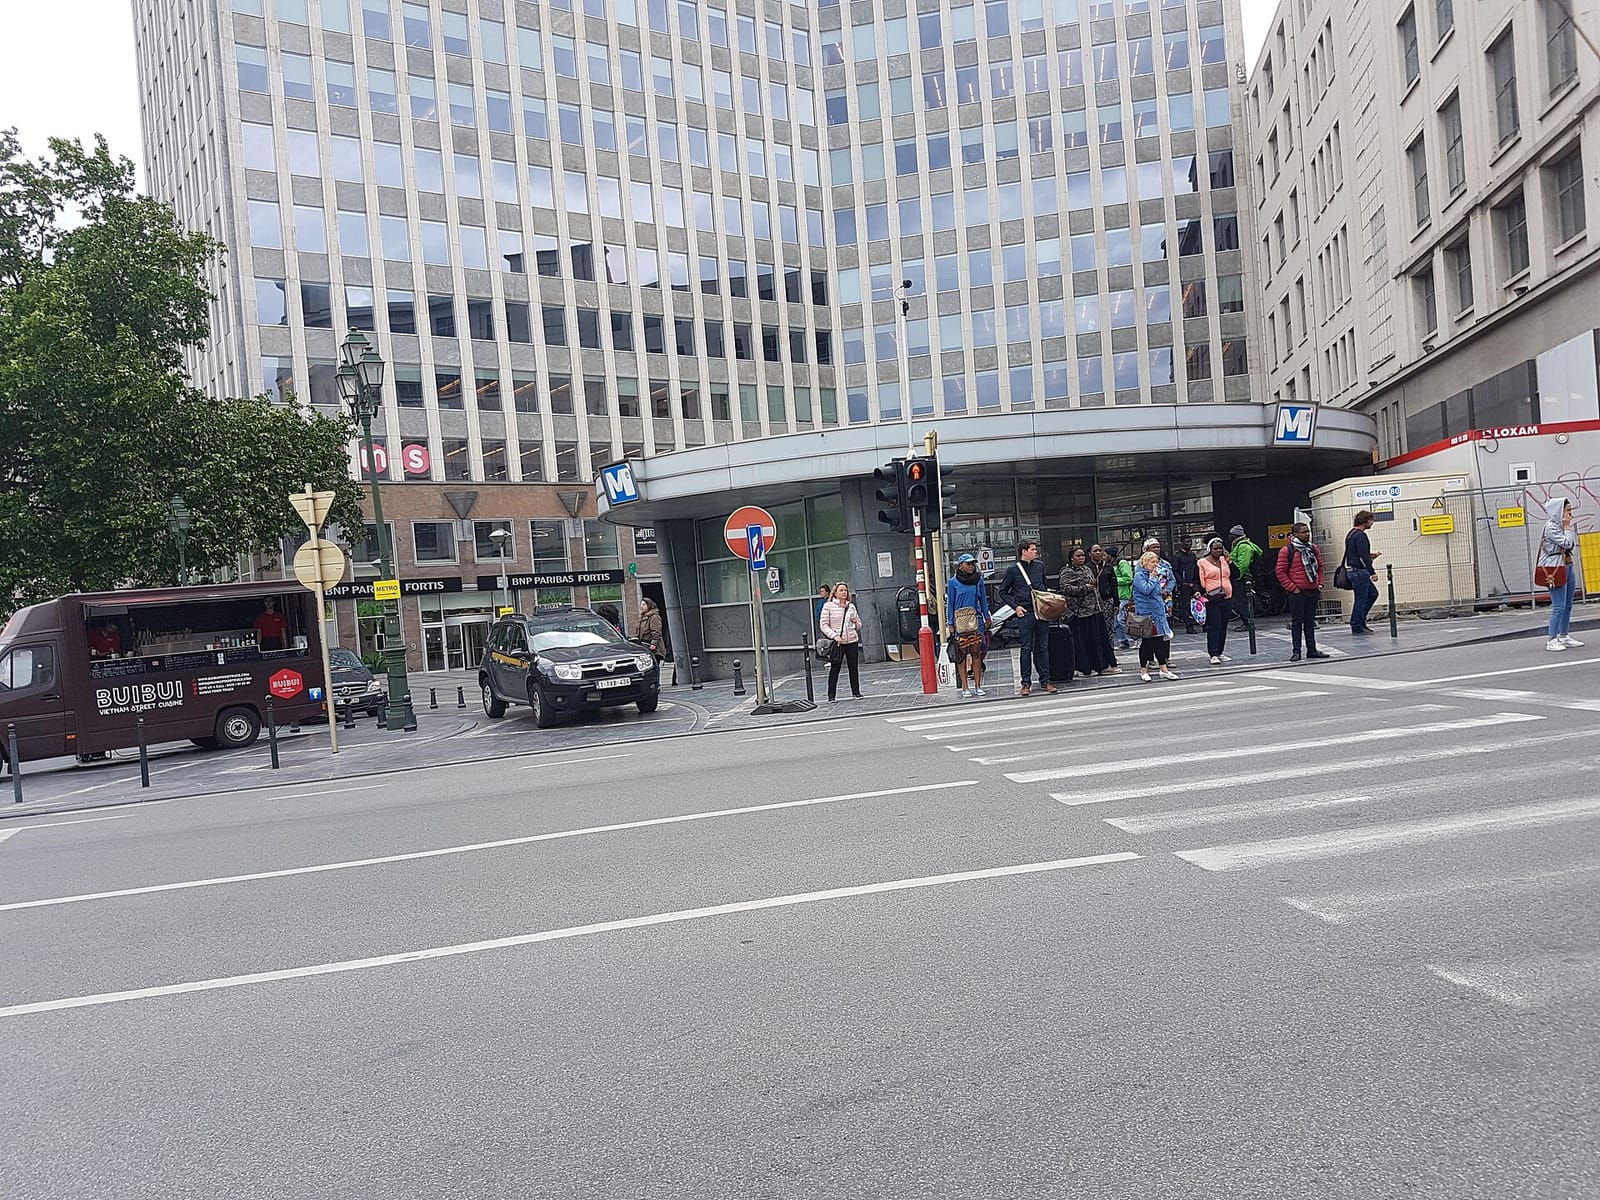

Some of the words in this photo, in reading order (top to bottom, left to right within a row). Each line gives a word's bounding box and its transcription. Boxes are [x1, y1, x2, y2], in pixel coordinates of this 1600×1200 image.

[1277, 408, 1311, 439] M
[1494, 426, 1538, 438] LOXAM
[605, 468, 636, 500] M
[1356, 488, 1388, 498] electro
[1499, 512, 1523, 520] METRO
[405, 581, 444, 591] FORTIS
[512, 577, 532, 586] BNP
[534, 575, 574, 585] PARIBAS
[578, 573, 610, 582] FORTIS
[96, 680, 184, 708] BUIBUI
[99, 706, 130, 716] VIETNAM
[131, 703, 156, 712] STREET
[158, 700, 184, 708] CUISINE
